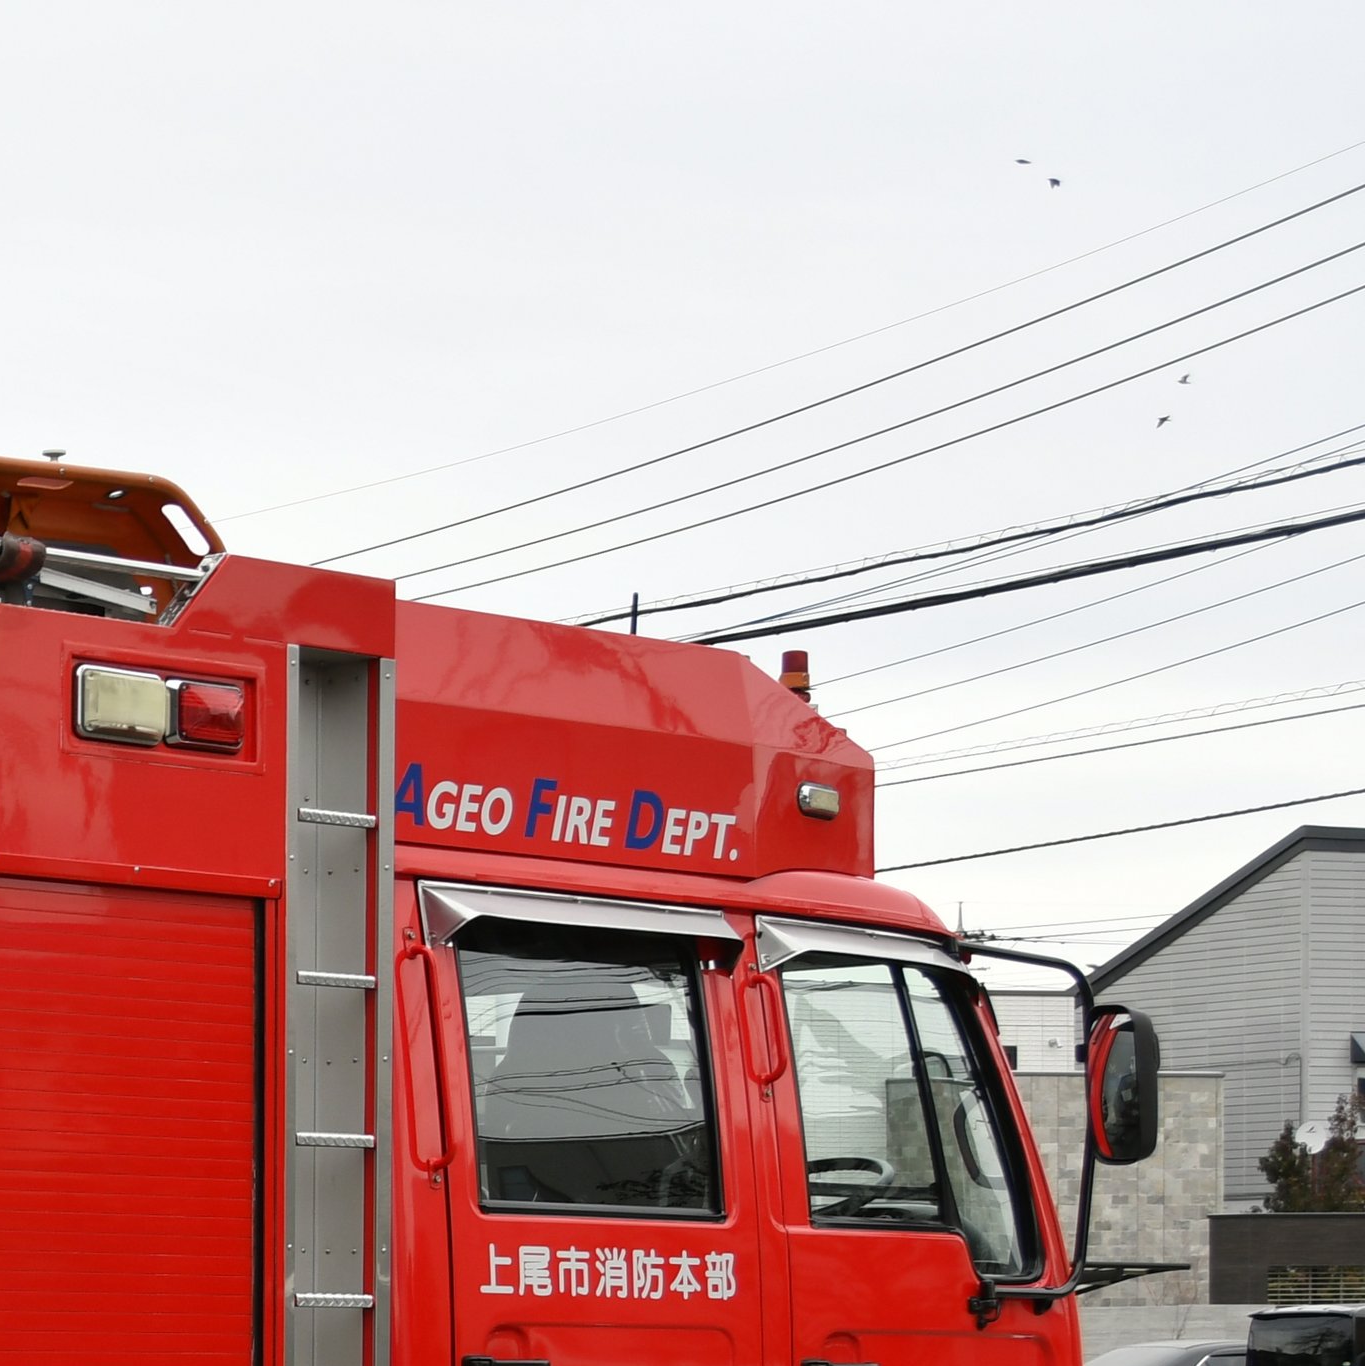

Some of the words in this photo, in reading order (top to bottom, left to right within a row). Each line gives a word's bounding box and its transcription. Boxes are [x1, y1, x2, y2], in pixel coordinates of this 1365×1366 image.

[395, 763, 514, 836] AGEO
[524, 778, 617, 847] FIRE
[624, 789, 739, 861] DEPT.
[479, 1242, 737, 1301] 上尾市消防本部
